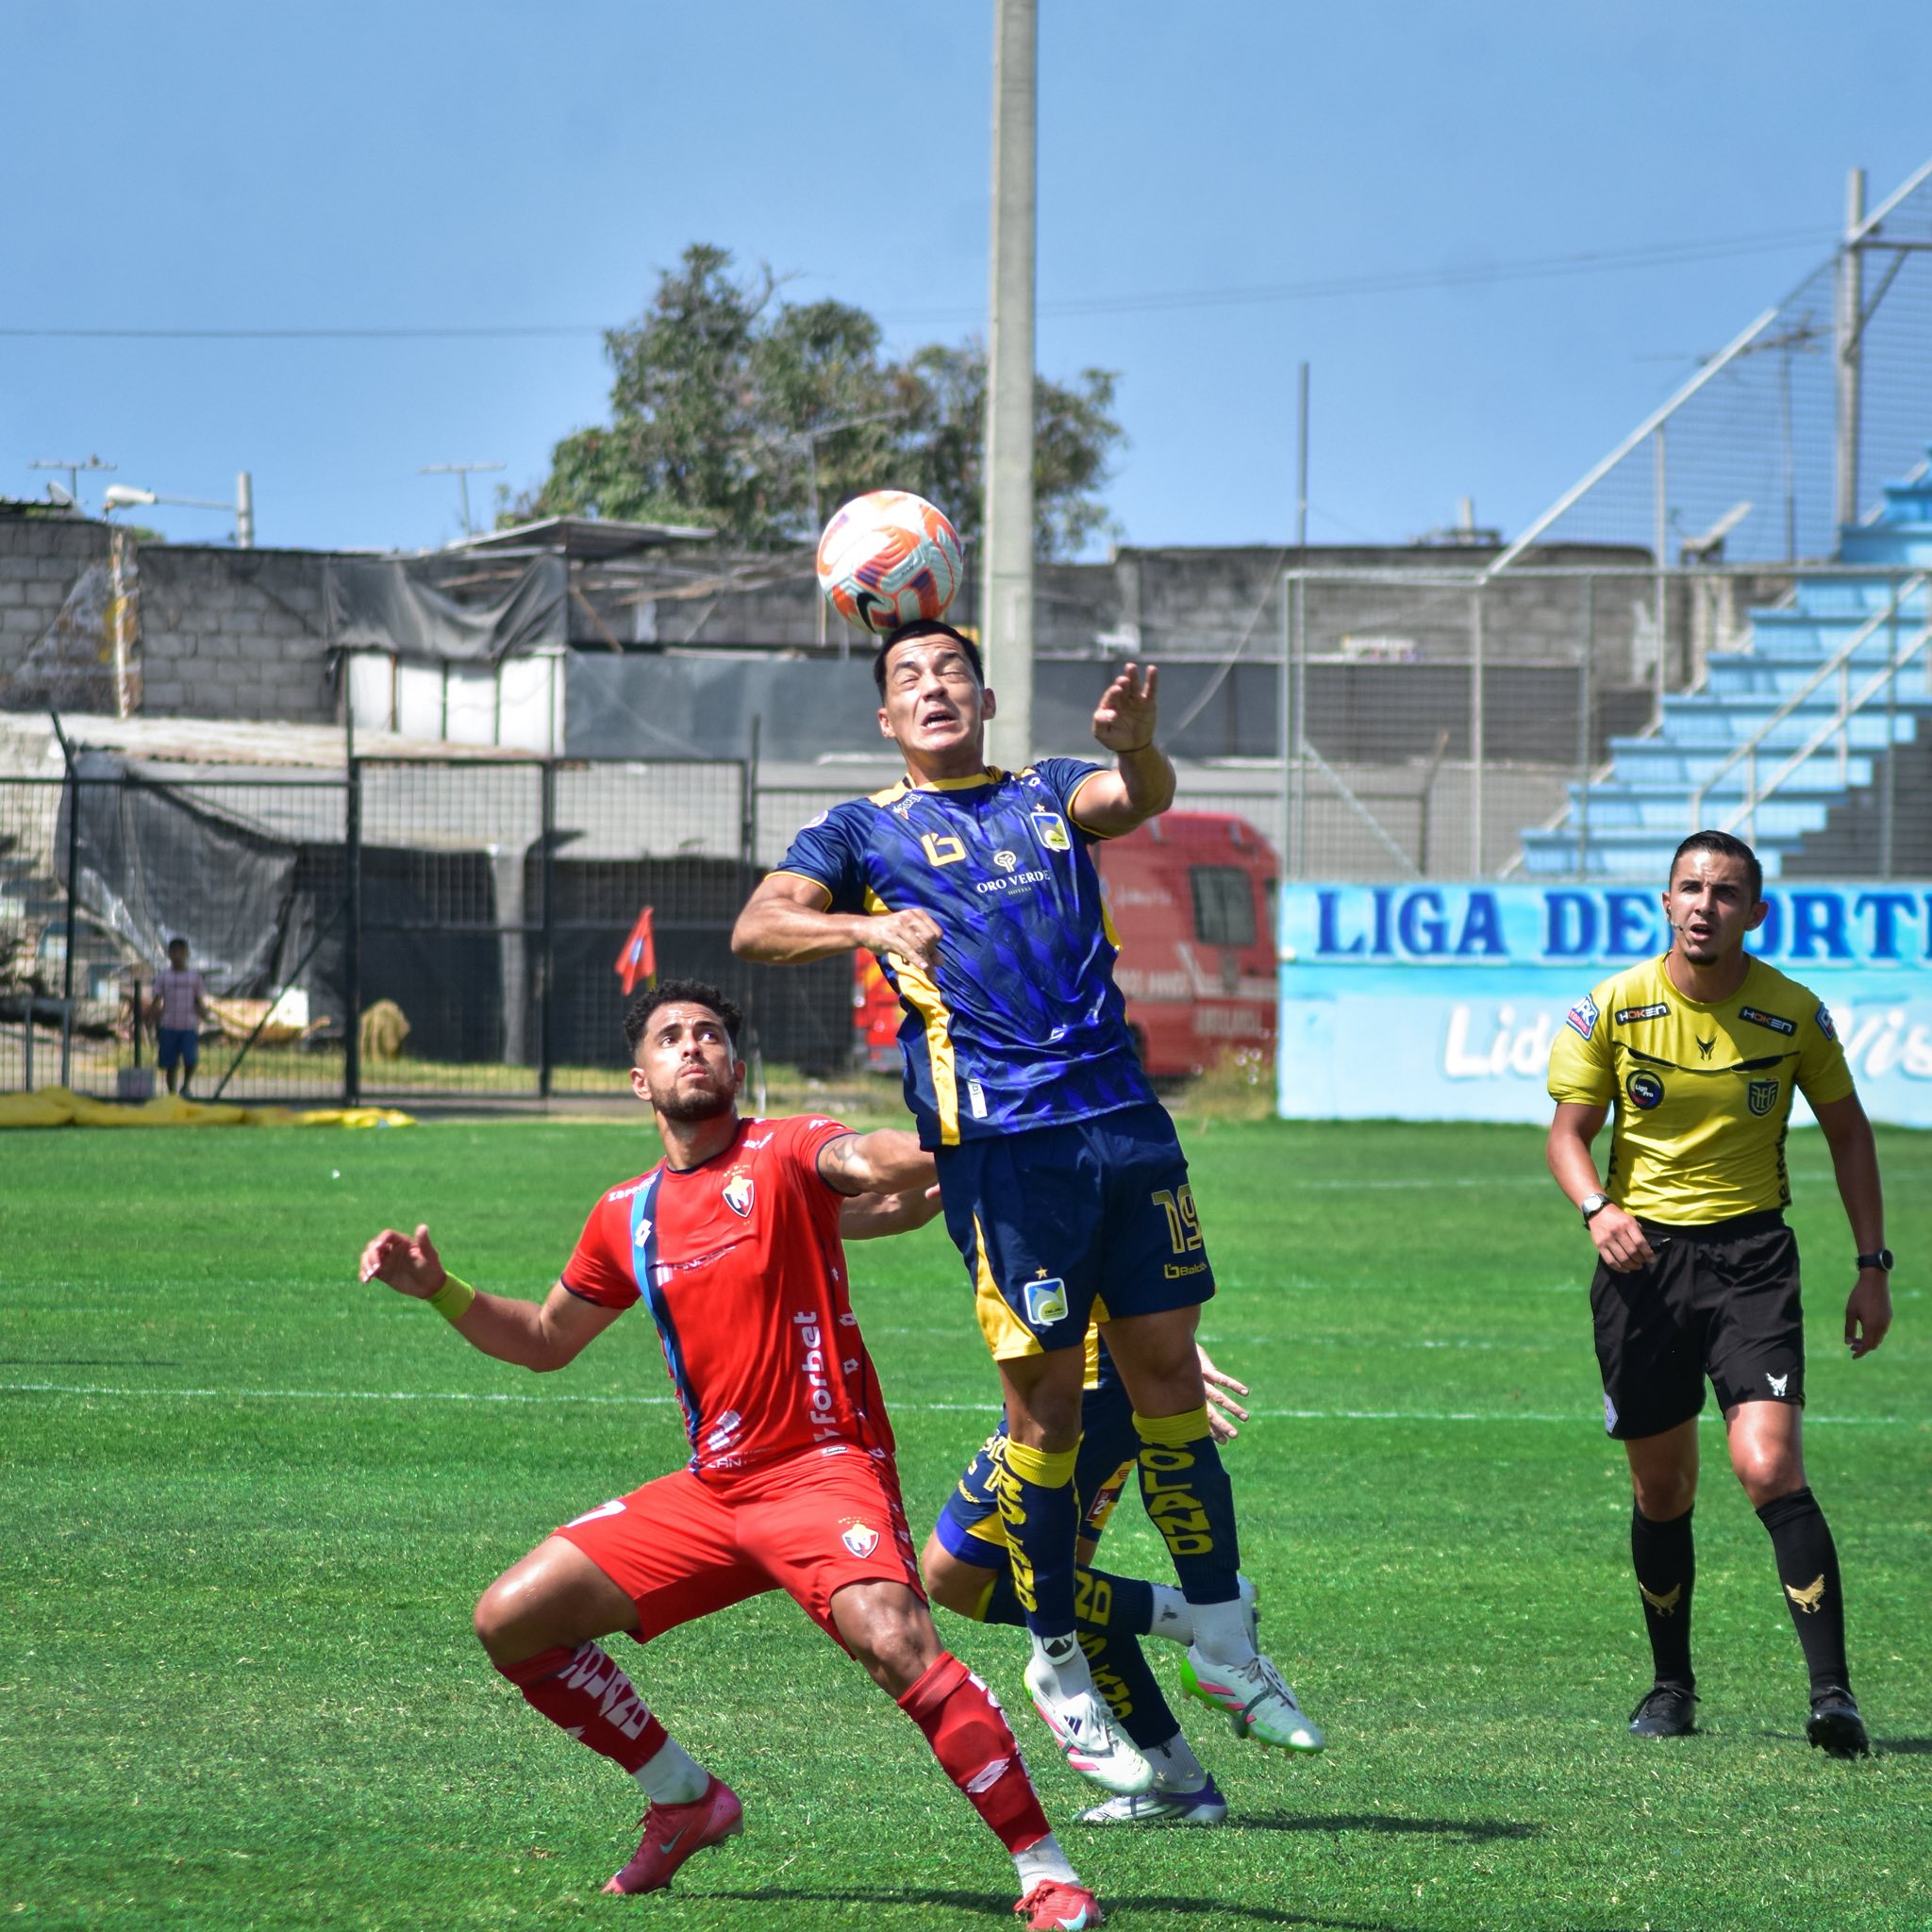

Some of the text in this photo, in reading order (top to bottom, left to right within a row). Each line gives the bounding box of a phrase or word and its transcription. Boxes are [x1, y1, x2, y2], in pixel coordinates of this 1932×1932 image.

[976, 869, 1051, 893] ORO VERDE
[1315, 891, 1508, 956] LIGA
[1619, 1004, 1667, 1022] HOKEN
[1742, 1008, 1792, 1033] HOKEN
[1151, 1183, 1202, 1255] 19
[793, 1311, 837, 1424] forbet
